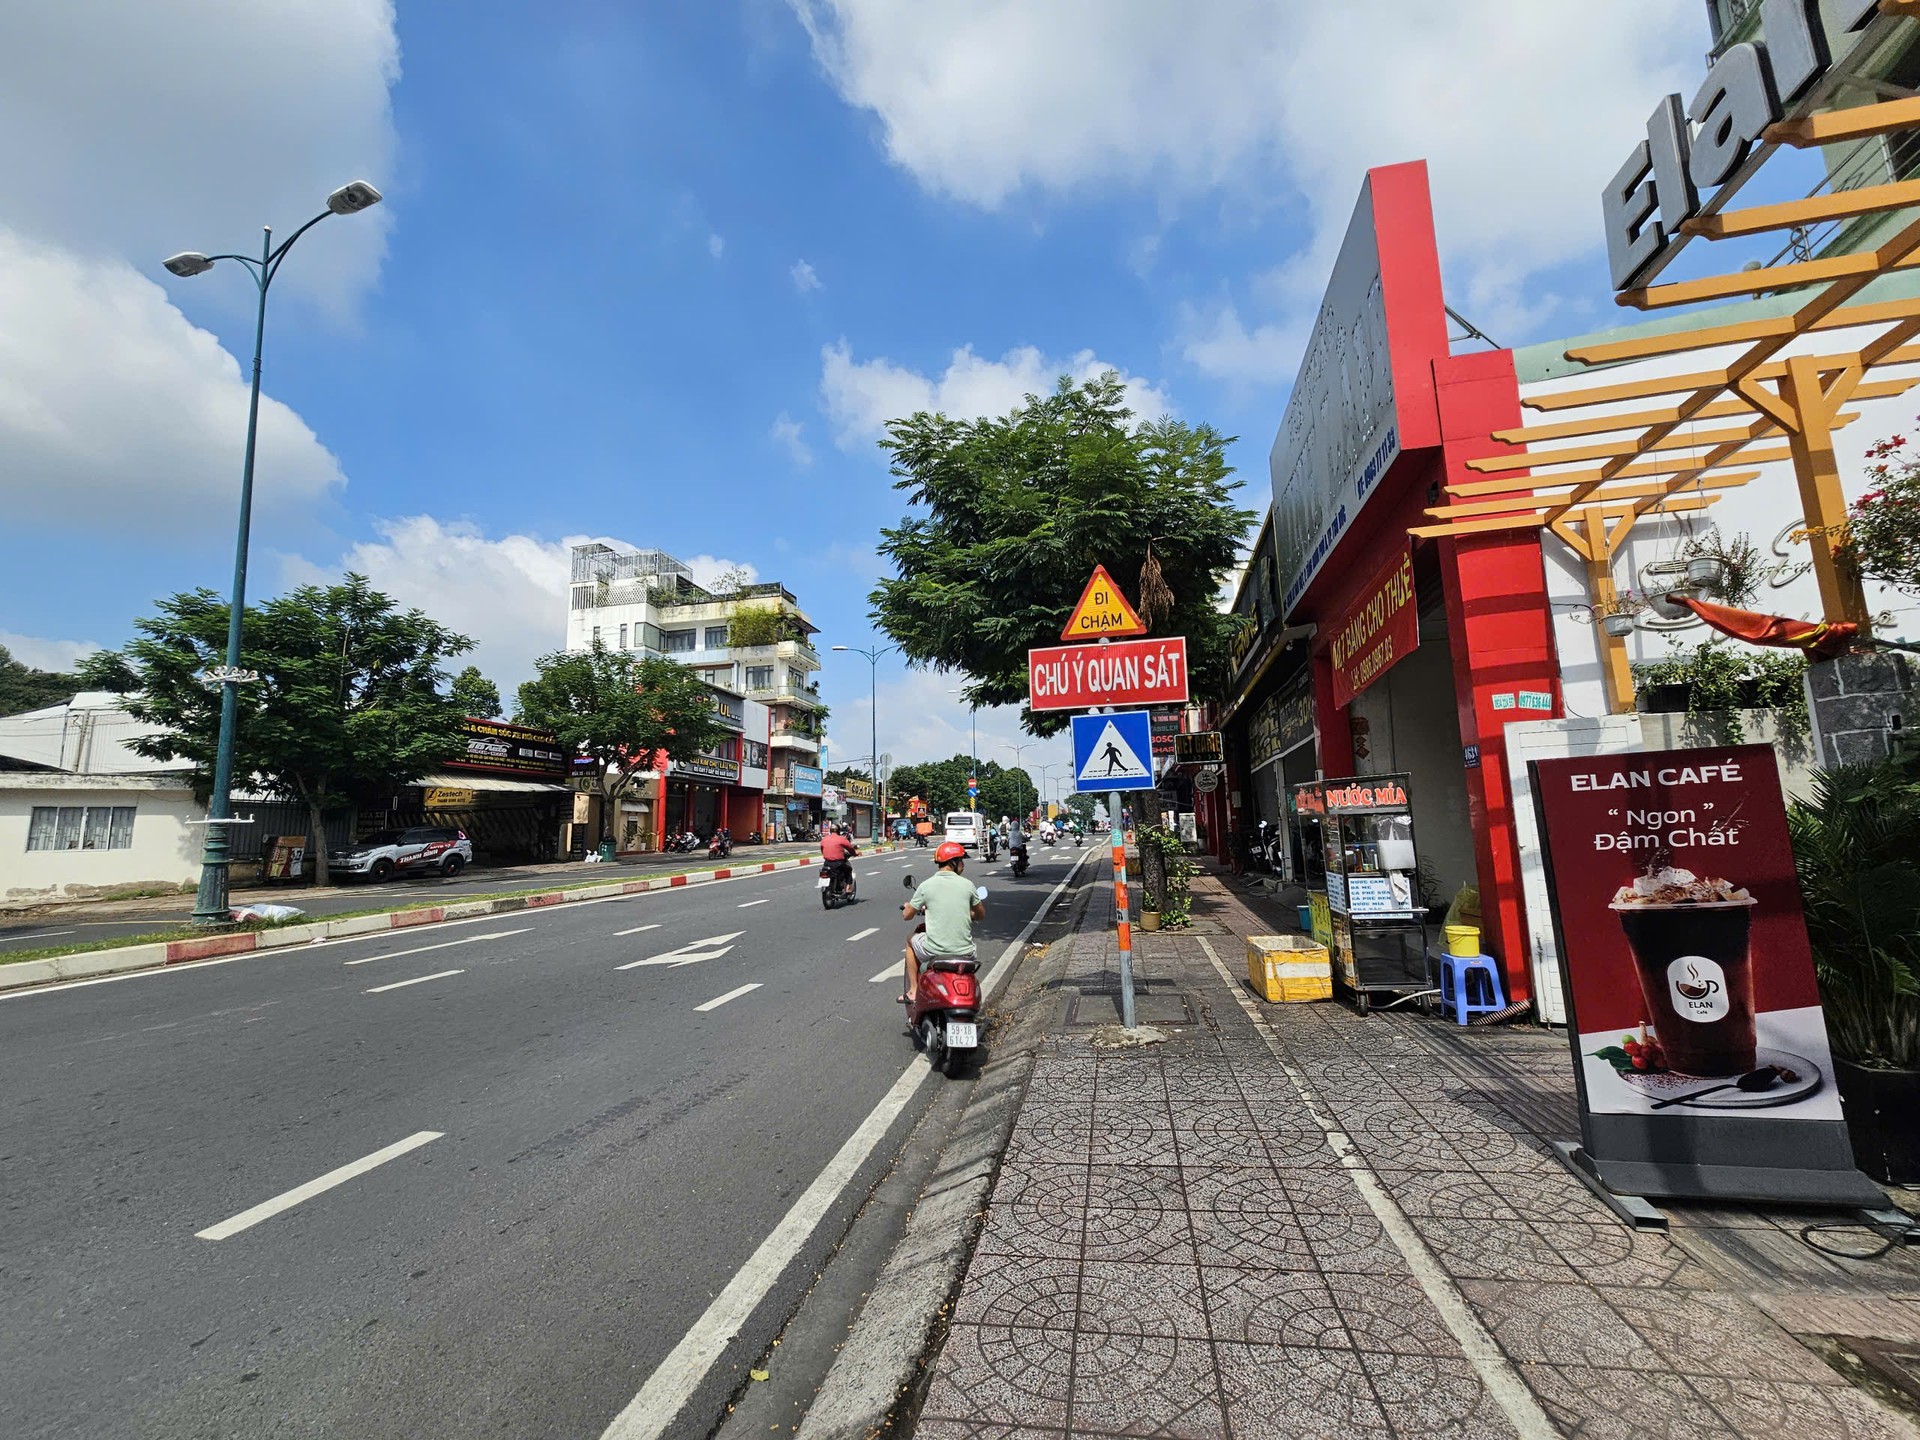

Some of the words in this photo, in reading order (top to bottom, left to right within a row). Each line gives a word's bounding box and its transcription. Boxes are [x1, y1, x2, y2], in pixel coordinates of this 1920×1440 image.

[1094, 591, 1109, 606] ĐI
[1367, 590, 1385, 638] CHO
[1385, 551, 1413, 618] THUÊ
[1080, 610, 1123, 632] CHẬM
[1034, 652, 1069, 697] CHÚ
[1072, 651, 1085, 693] Ý
[1087, 656, 1139, 694] QUAN
[1143, 645, 1181, 689] SÁT
[1570, 766, 1653, 792] ELAN
[1657, 758, 1744, 787] CAFÉ
[1326, 783, 1372, 807] NƯỚC
[1375, 781, 1407, 805] MÍA
[1626, 807, 1697, 830] Ngon
[1594, 832, 1661, 854] Đậm
[1668, 820, 1740, 848] Chất
[1688, 1001, 1713, 1009] ELAN
